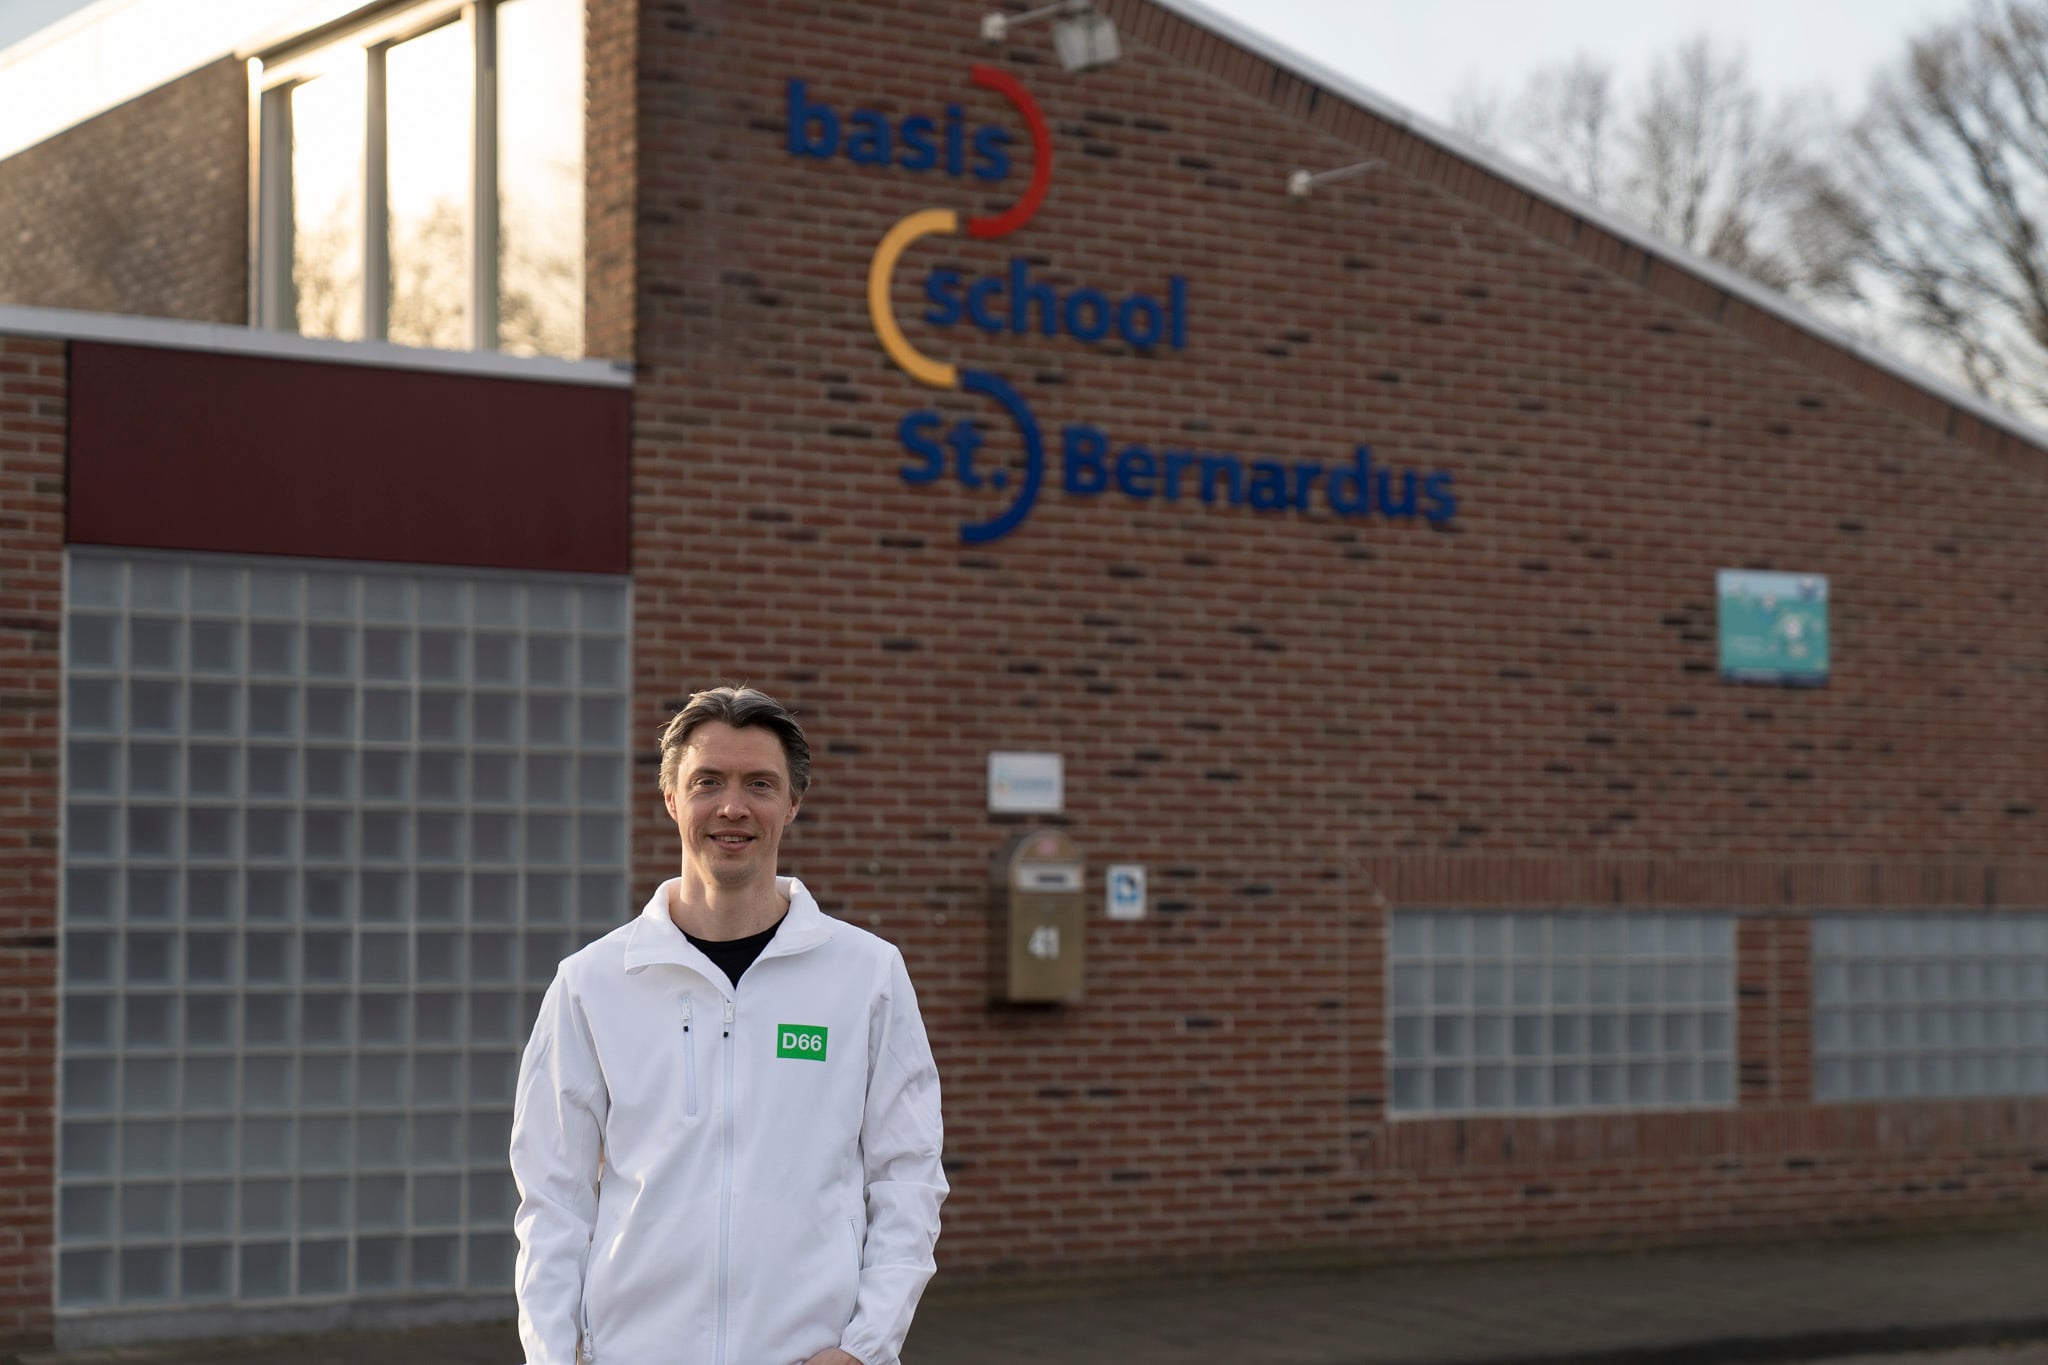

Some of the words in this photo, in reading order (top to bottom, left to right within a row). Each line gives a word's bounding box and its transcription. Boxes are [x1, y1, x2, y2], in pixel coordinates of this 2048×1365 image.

[786, 78, 1013, 181] basis
[922, 258, 1188, 350] school
[897, 410, 1009, 488] St.
[1061, 425, 1458, 524] Bernardus
[1028, 925, 1060, 959] 41
[782, 1032, 823, 1052] D66
